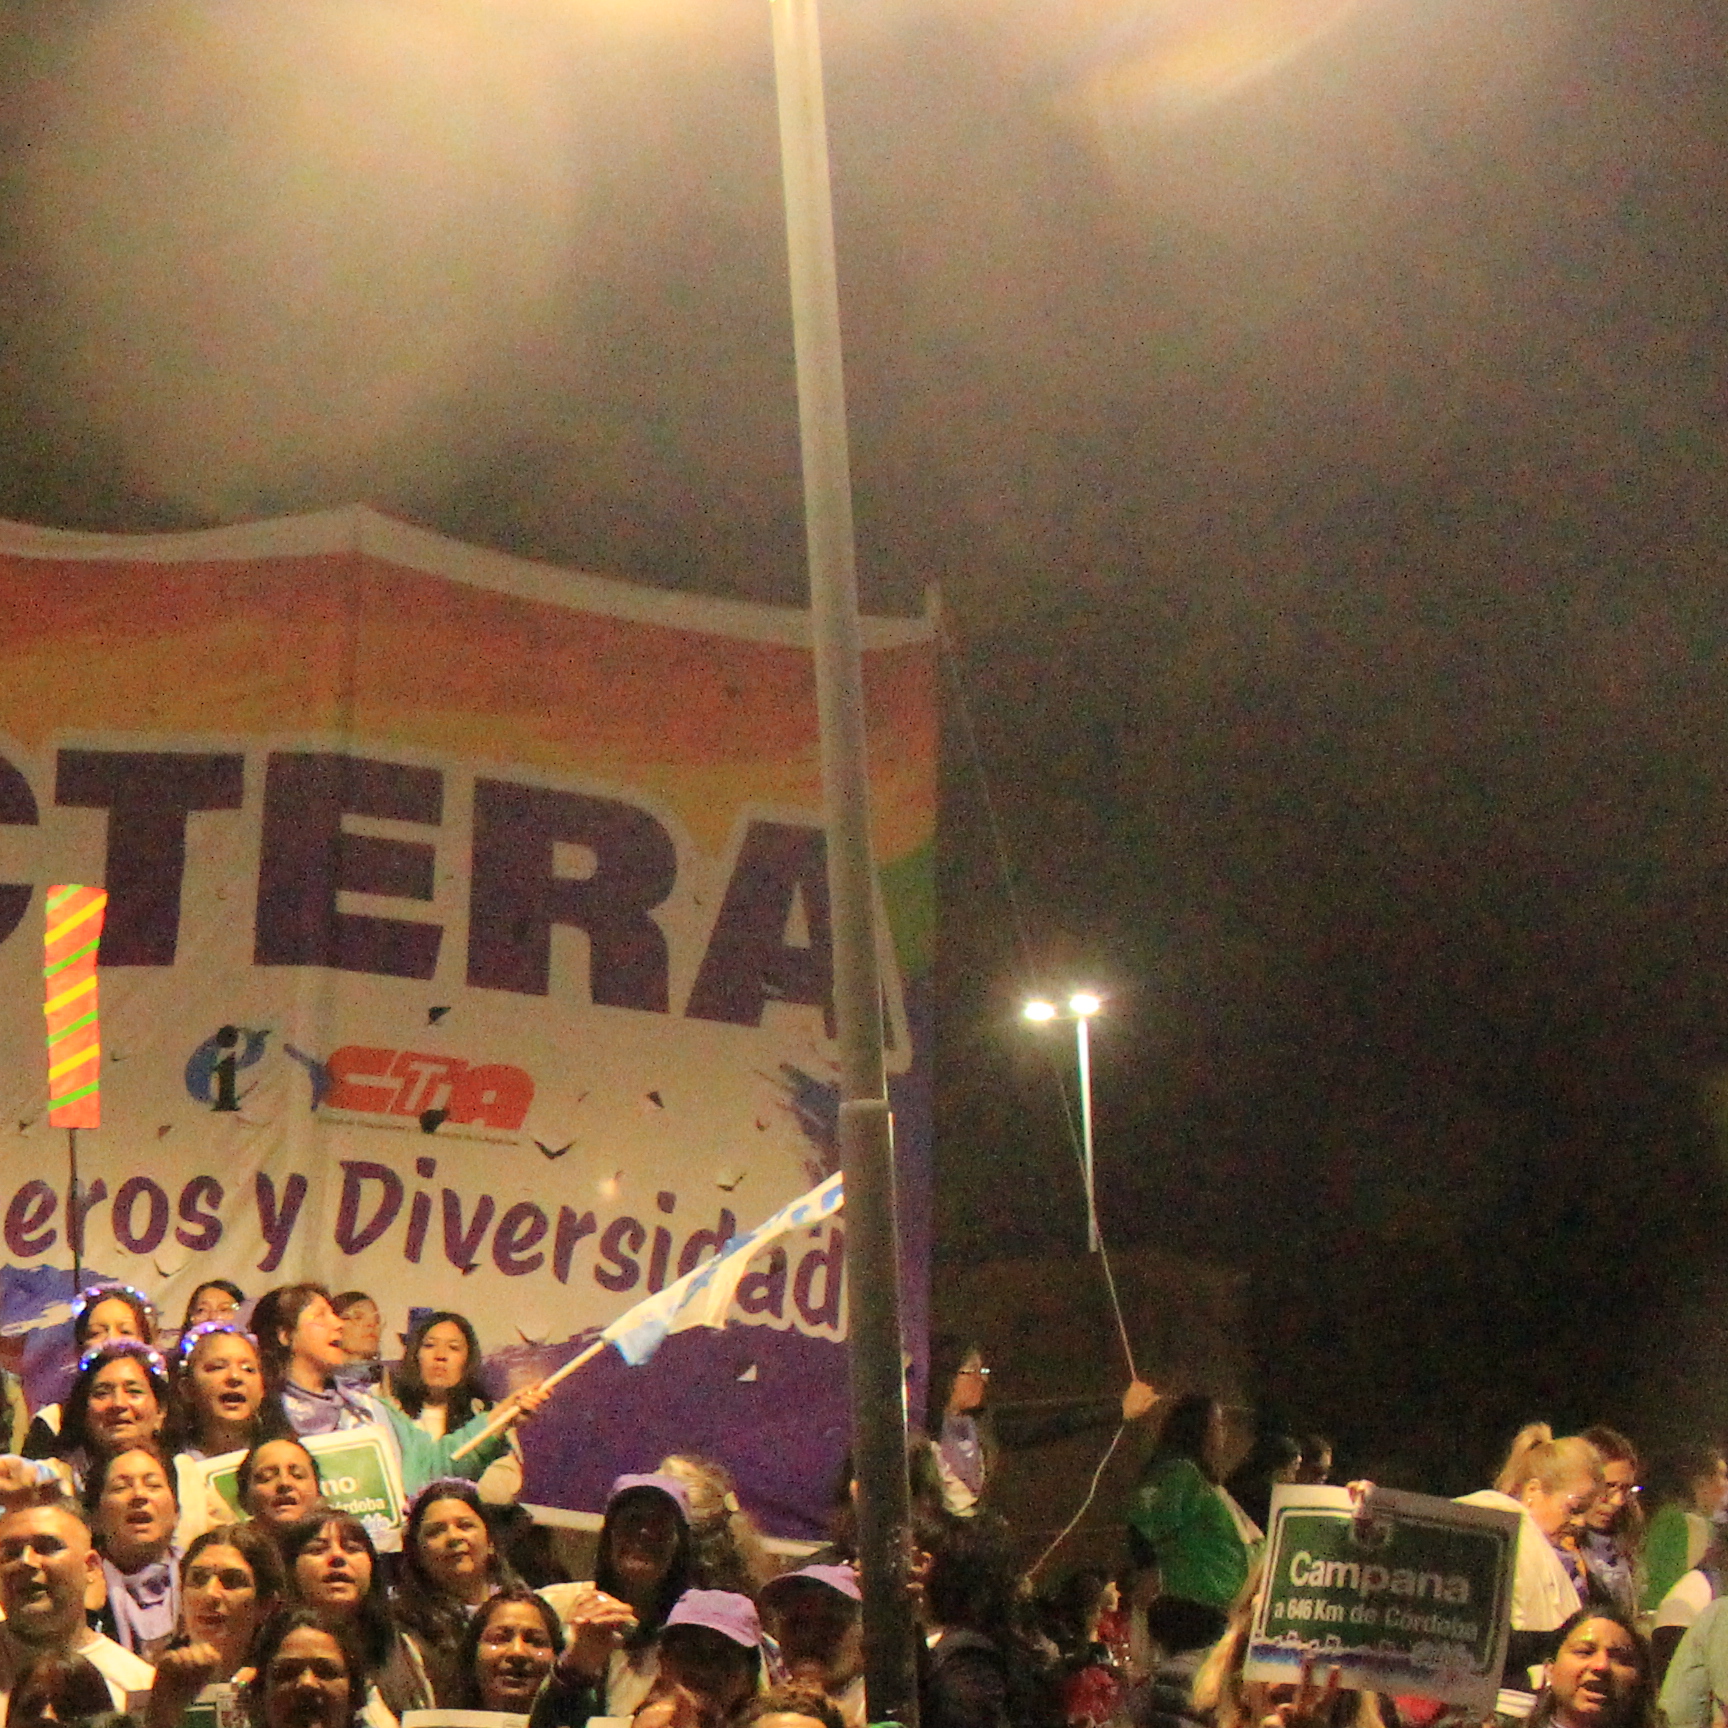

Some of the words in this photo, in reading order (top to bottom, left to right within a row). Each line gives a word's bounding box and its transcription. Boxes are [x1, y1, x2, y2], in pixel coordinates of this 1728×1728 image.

[255, 1171, 309, 1273] y
[1289, 1549, 1470, 1605] Campana
[1274, 1601, 1284, 1619] a
[1314, 1601, 1344, 1624] Km
[1349, 1602, 1379, 1625] de
